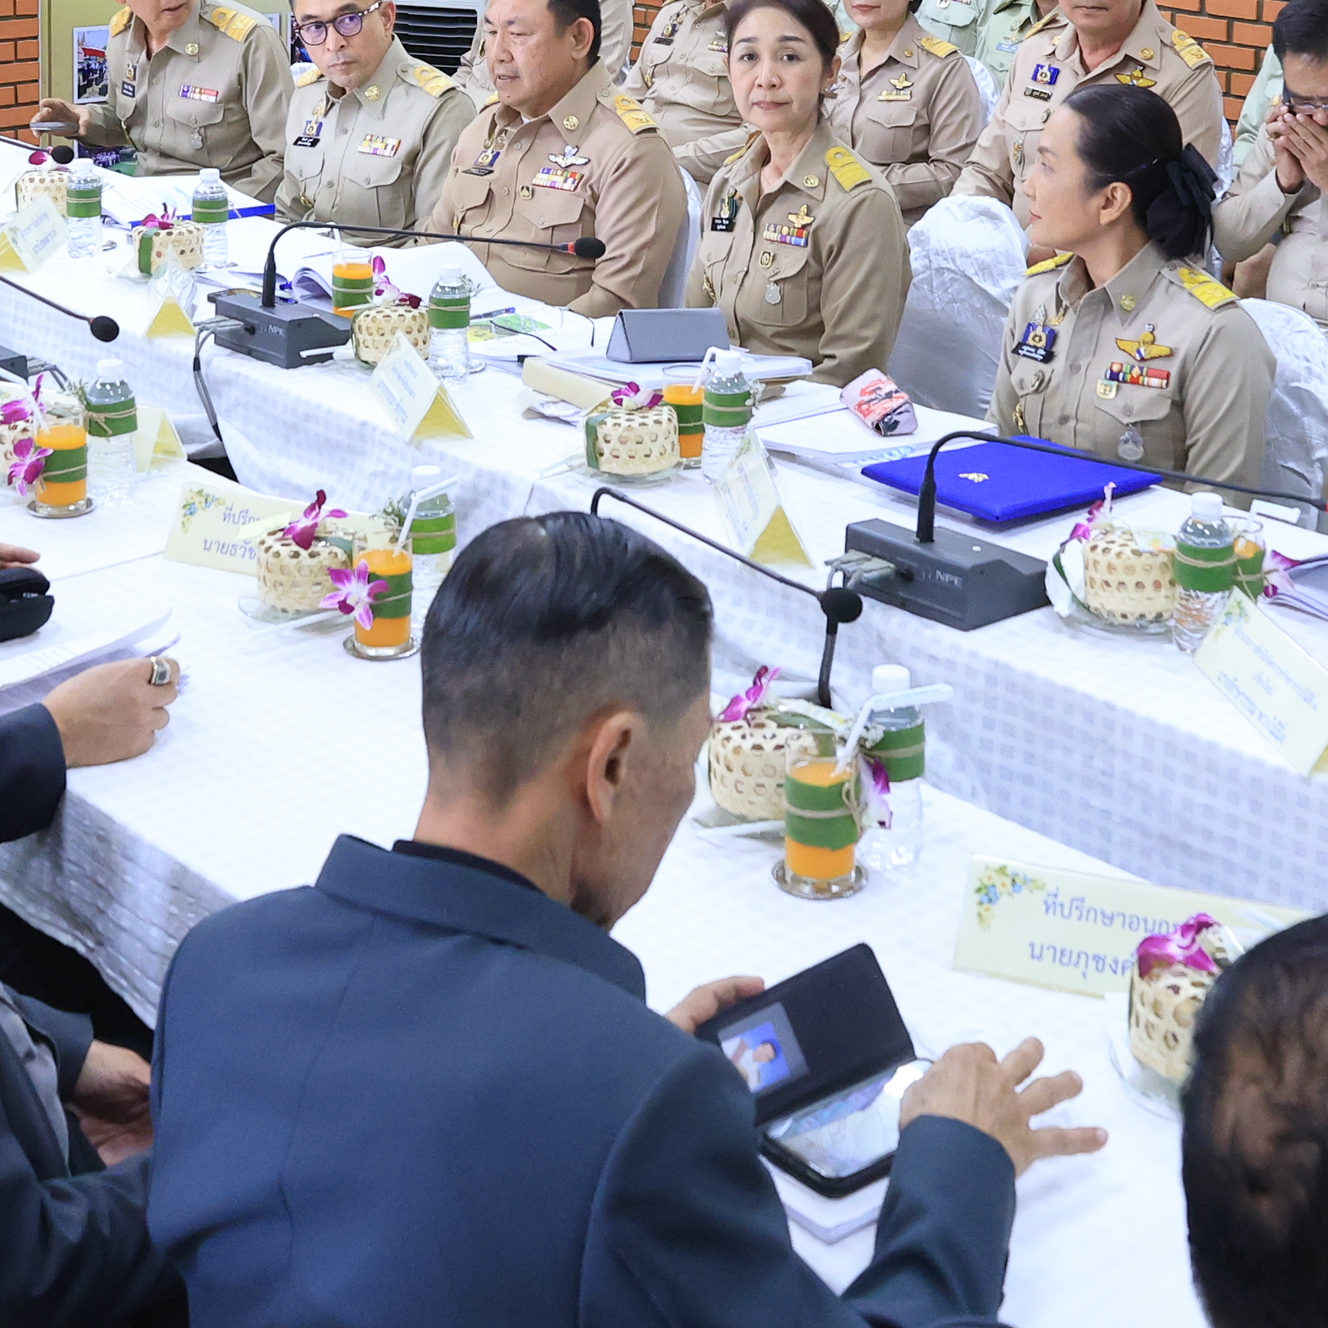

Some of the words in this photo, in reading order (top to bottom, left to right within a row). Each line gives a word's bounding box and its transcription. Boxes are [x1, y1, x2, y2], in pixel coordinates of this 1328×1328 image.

[268, 324, 284, 336] NPE
[223, 503, 260, 525] ที่ปรึก
[1043, 886, 1177, 935] ที่ปรึกษาอนก
